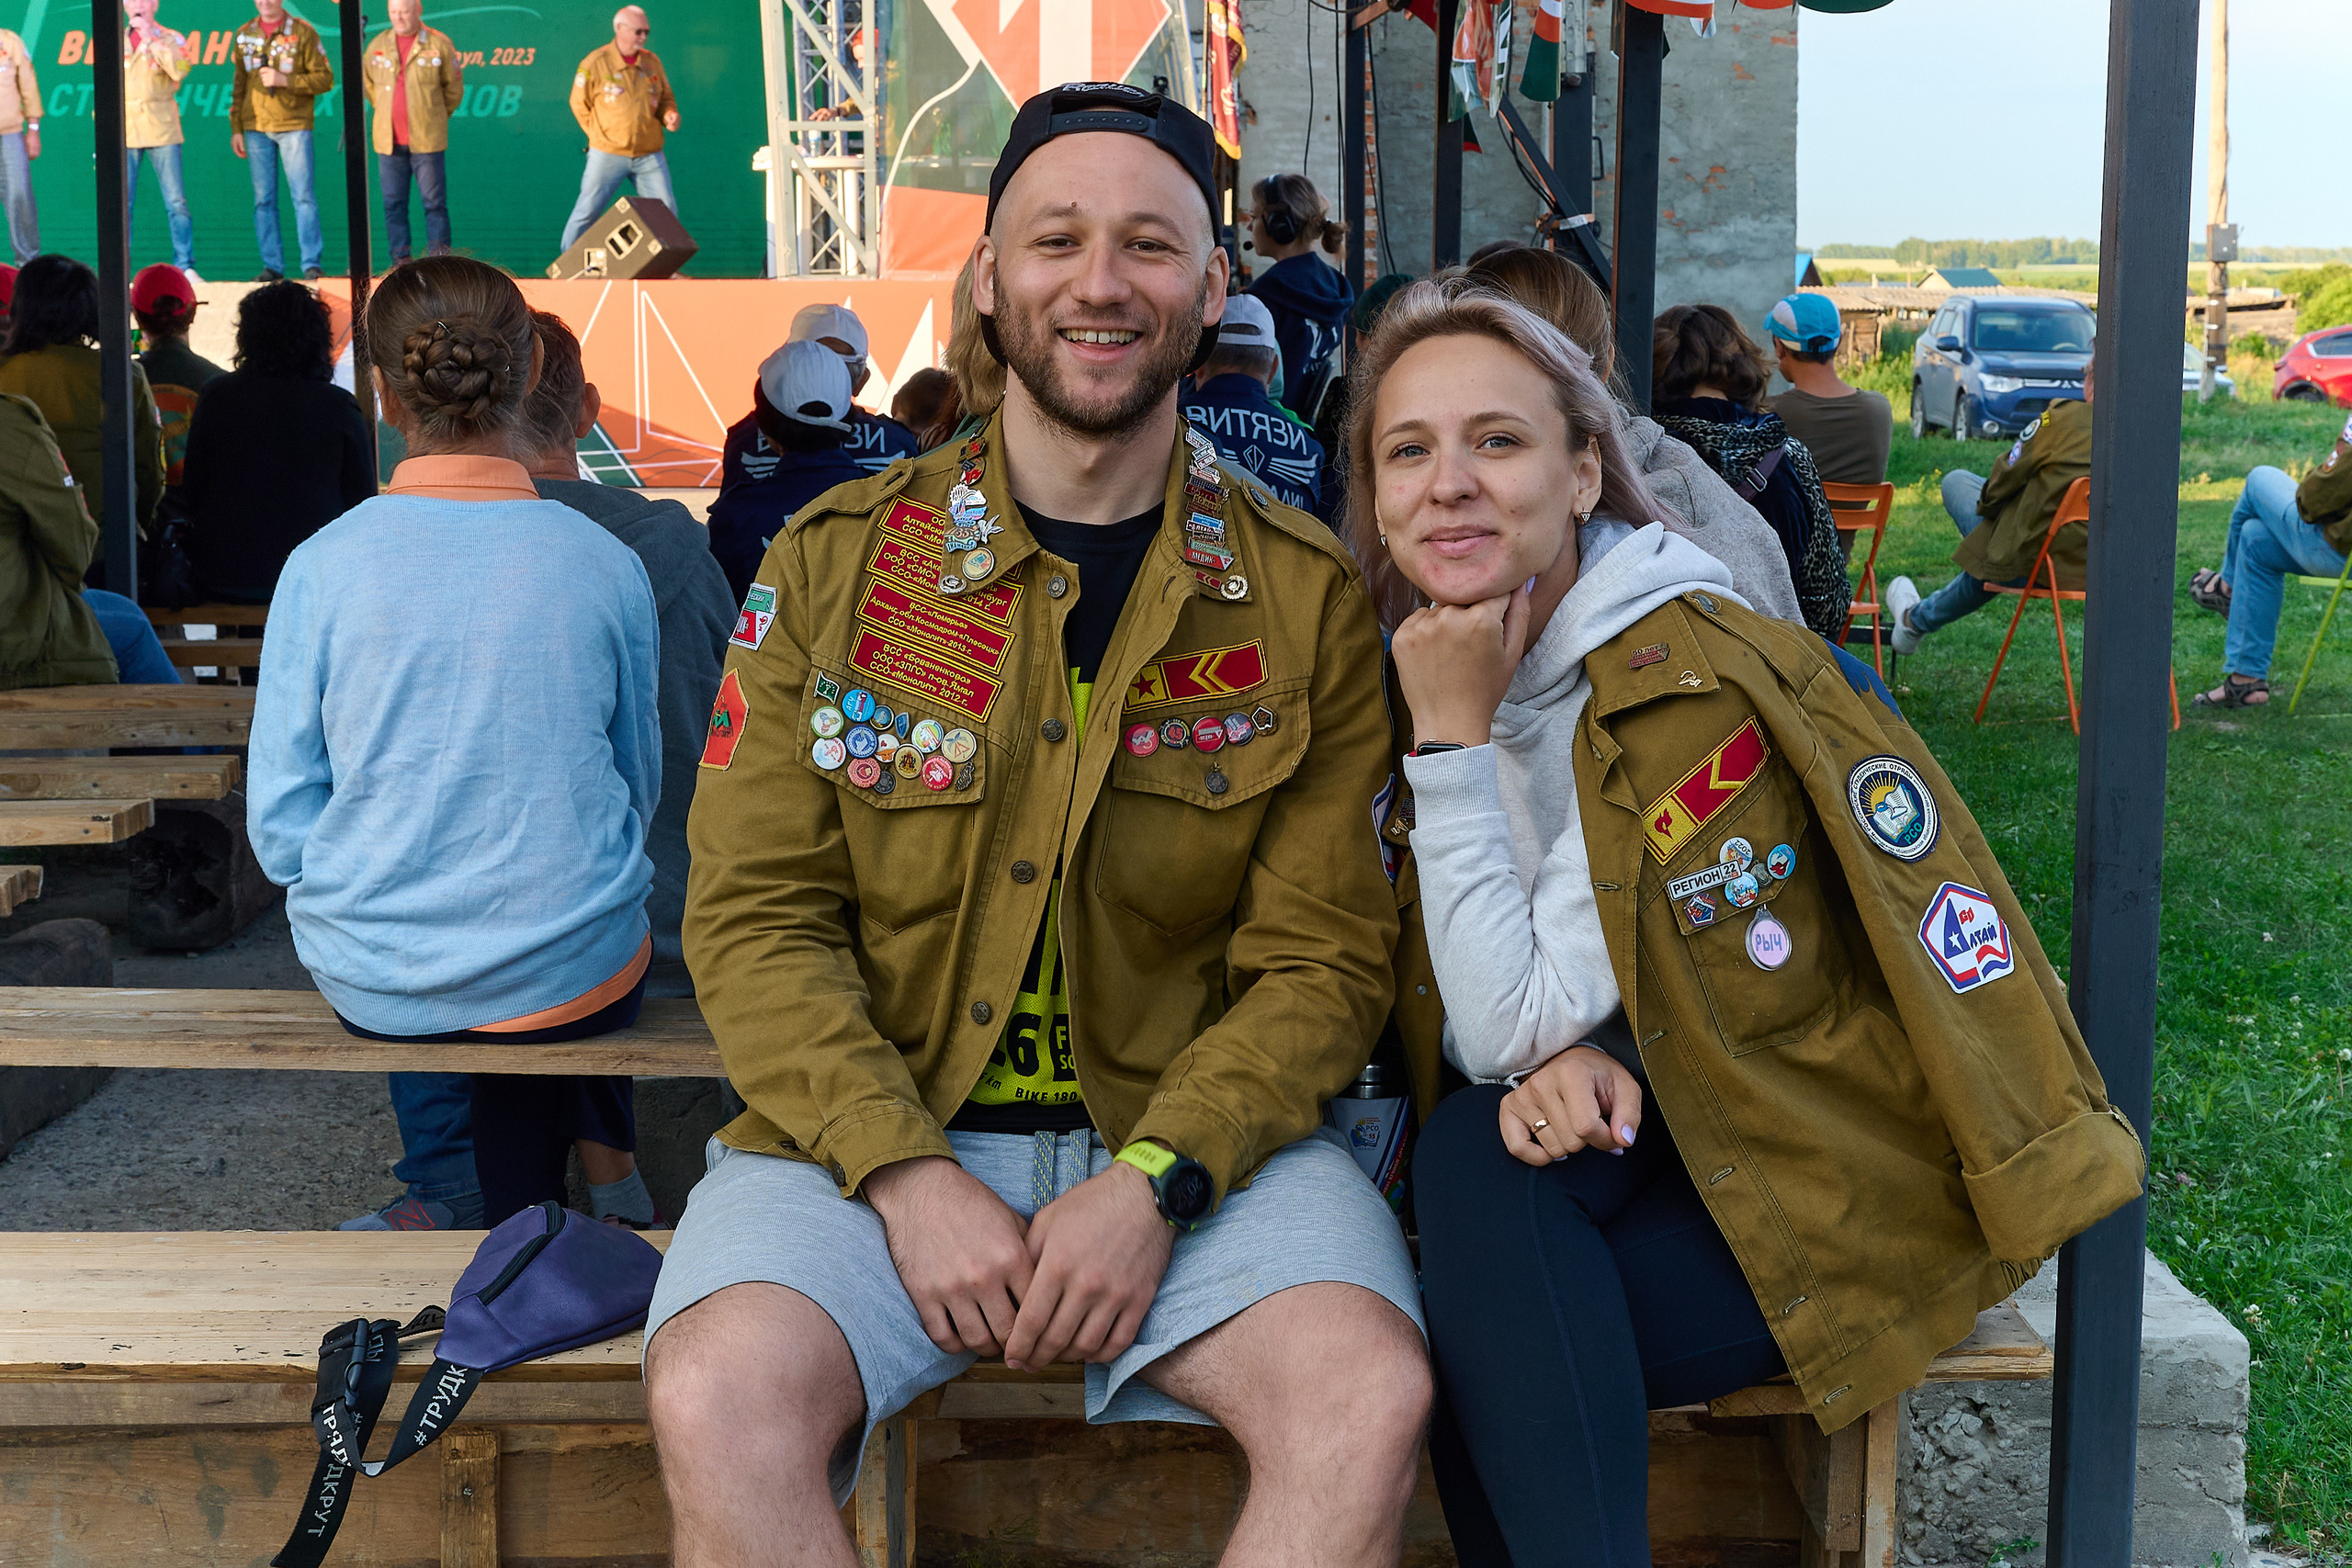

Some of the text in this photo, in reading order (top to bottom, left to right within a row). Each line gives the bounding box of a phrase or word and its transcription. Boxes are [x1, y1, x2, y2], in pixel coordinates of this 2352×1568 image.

[490, 48, 536, 65] 2023
[883, 552, 906, 567] ООО
[899, 548, 920, 563] ВСС
[890, 565, 911, 580] ССО
[909, 602, 927, 614] ВСС
[888, 615, 906, 628] ССО
[948, 638, 967, 651] 2013
[872, 650, 894, 665] ООО
[883, 643, 903, 657] ВСС
[869, 660, 891, 675] ССО
[938, 687, 960, 702] 2012
[1904, 821, 1923, 845] РСО
[1671, 862, 1737, 896] РЕГИОН 22
[1755, 932, 1783, 952] РЫЧ
[1015, 1086, 1078, 1102] BIKE 180
